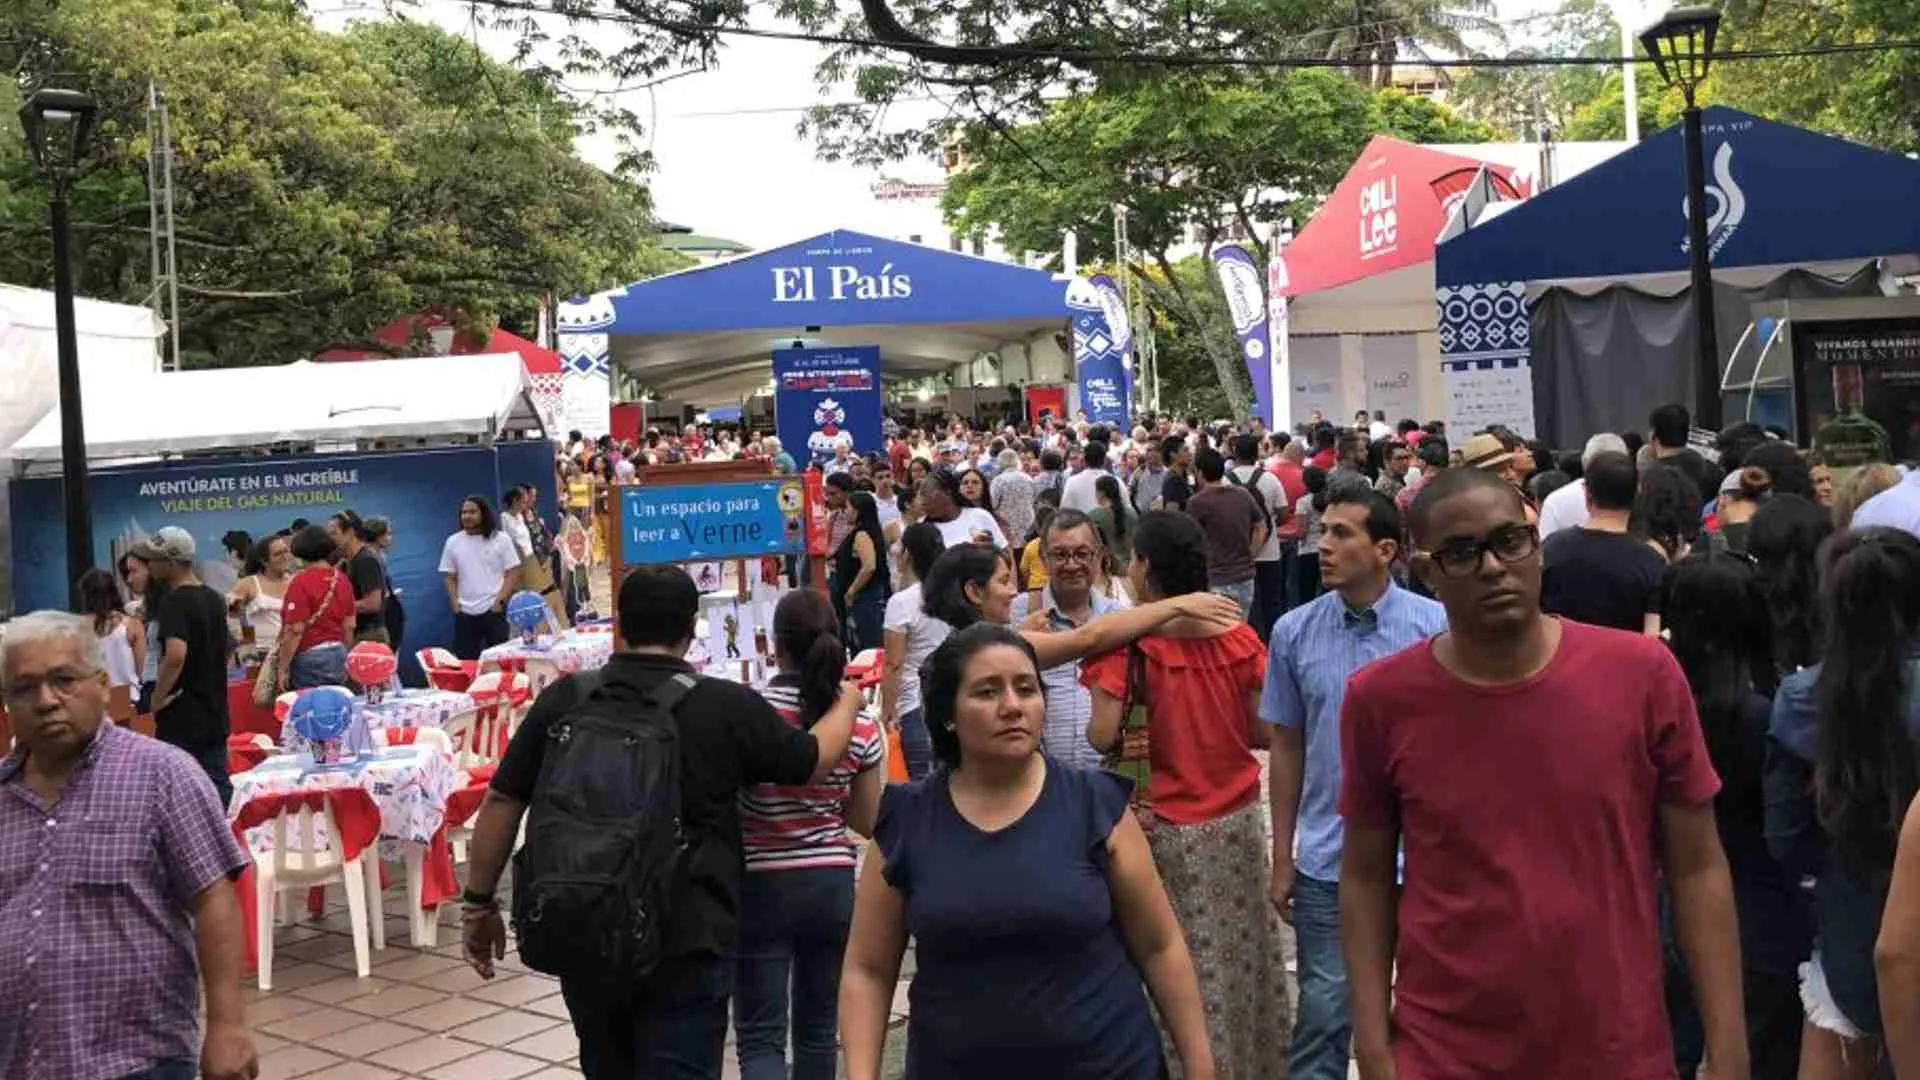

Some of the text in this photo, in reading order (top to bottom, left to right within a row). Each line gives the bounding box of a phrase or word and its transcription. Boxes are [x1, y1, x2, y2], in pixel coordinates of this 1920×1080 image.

[770, 262, 912, 302] El País
[1815, 339, 1868, 350] VIVAMOS
[140, 468, 358, 496] AVENTÚRATE EN EL INCREÍBLE
[161, 490, 344, 513] VIAJE DEL GAS NATURAL
[632, 496, 760, 519] Un espacio para
[633, 518, 762, 545] leer a Verne
